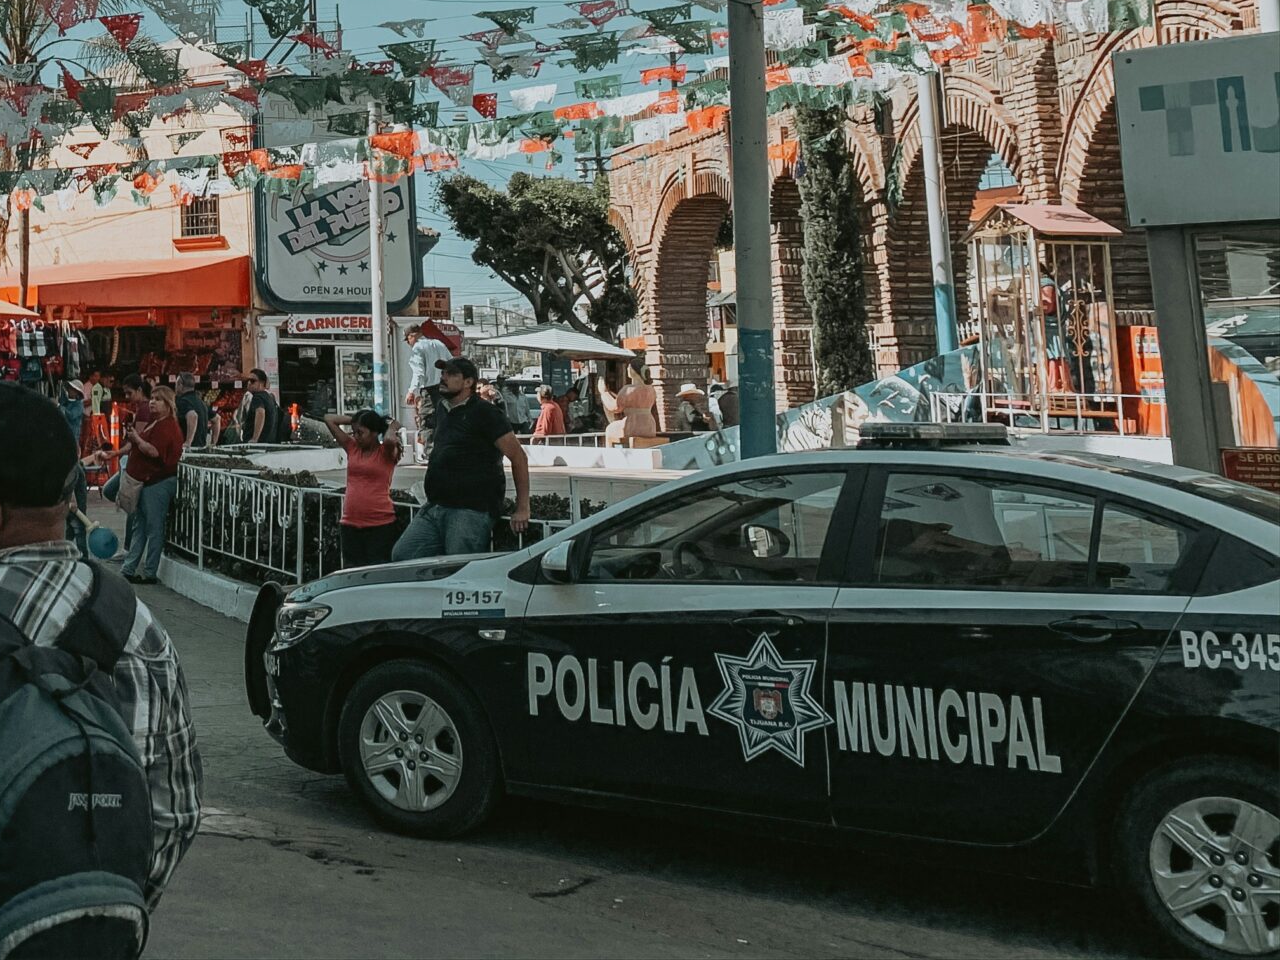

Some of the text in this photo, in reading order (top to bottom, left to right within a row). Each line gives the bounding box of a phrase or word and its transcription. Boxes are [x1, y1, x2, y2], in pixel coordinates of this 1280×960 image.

[287, 191, 401, 252] DEL PUEO
[293, 200, 330, 228] LA
[303, 285, 330, 295] OPEN
[333, 286, 344, 295] 24
[295, 316, 373, 333] CARNICERI
[1239, 453, 1255, 463] SE
[446, 591, 503, 605] 19-157
[1180, 630, 1280, 672] BC-345
[528, 652, 1063, 774] POLICÍA MUNICIPAL
[750, 719, 777, 727] TIJUANA
